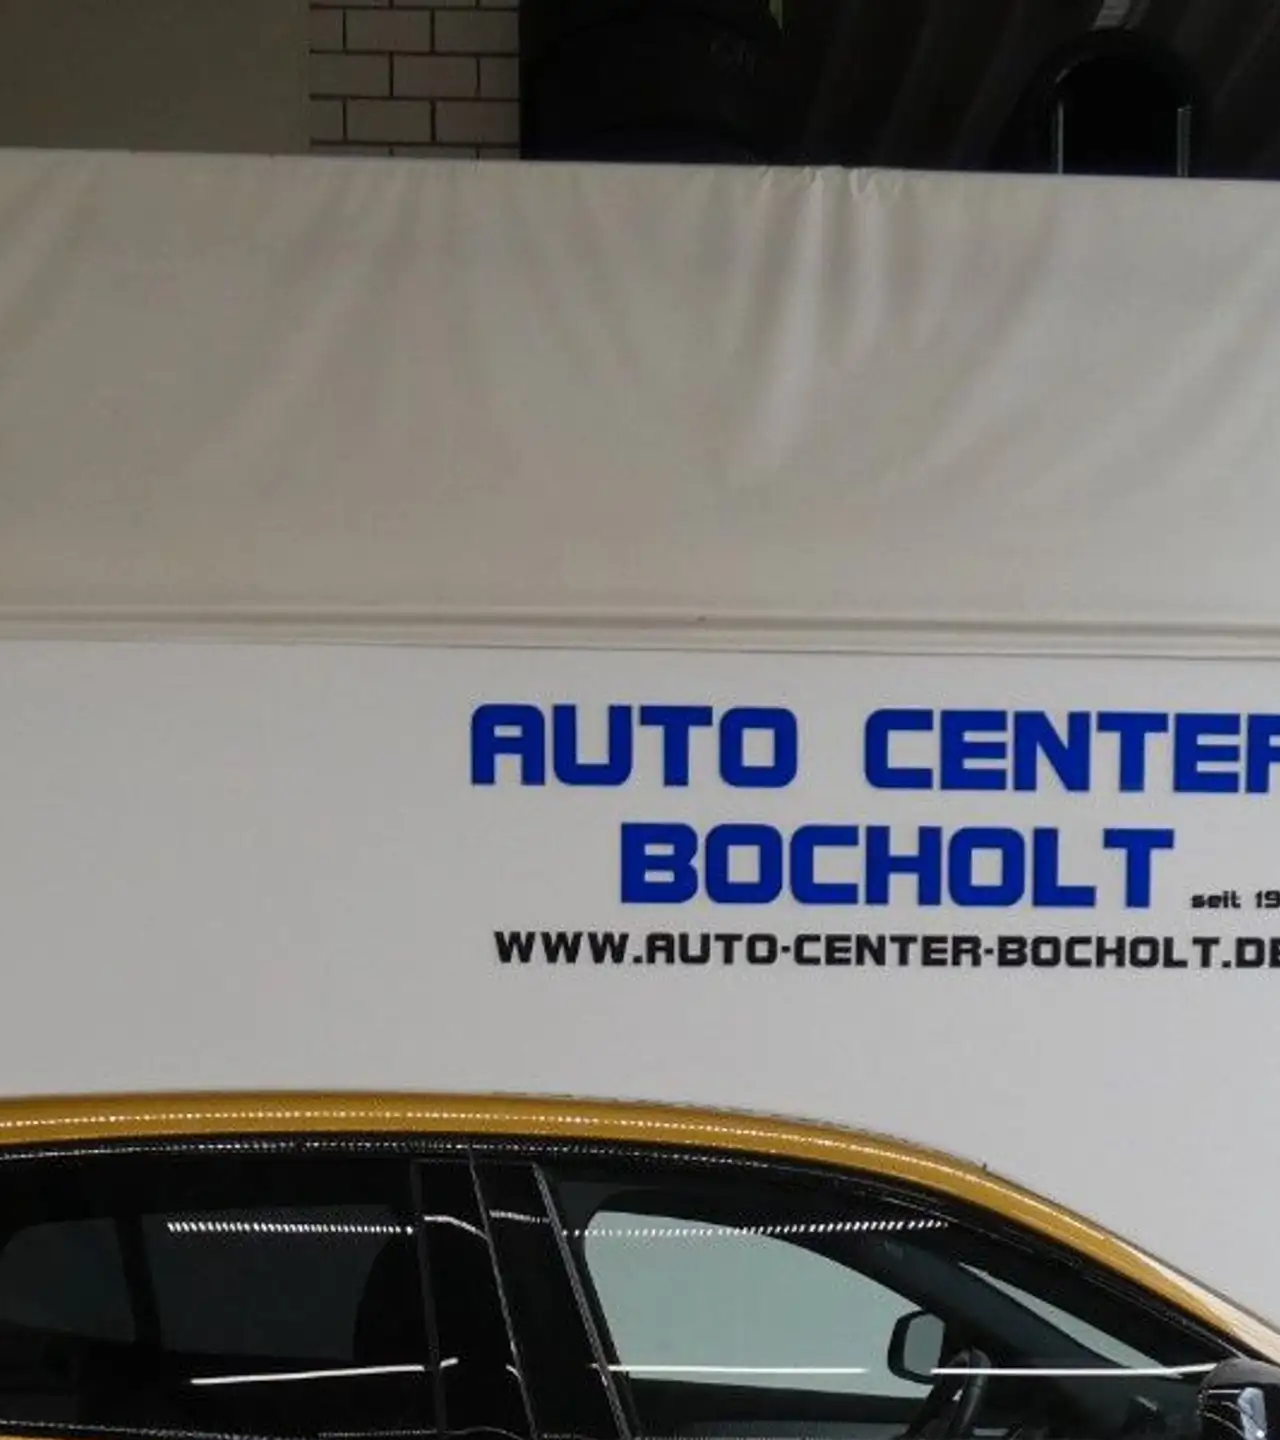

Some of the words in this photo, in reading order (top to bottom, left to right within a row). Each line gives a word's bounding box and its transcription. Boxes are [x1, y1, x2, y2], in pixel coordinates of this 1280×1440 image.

[471, 703, 799, 788] AUTO
[621, 822, 1175, 909] BOCHOLT
[1191, 890, 1241, 910] seit
